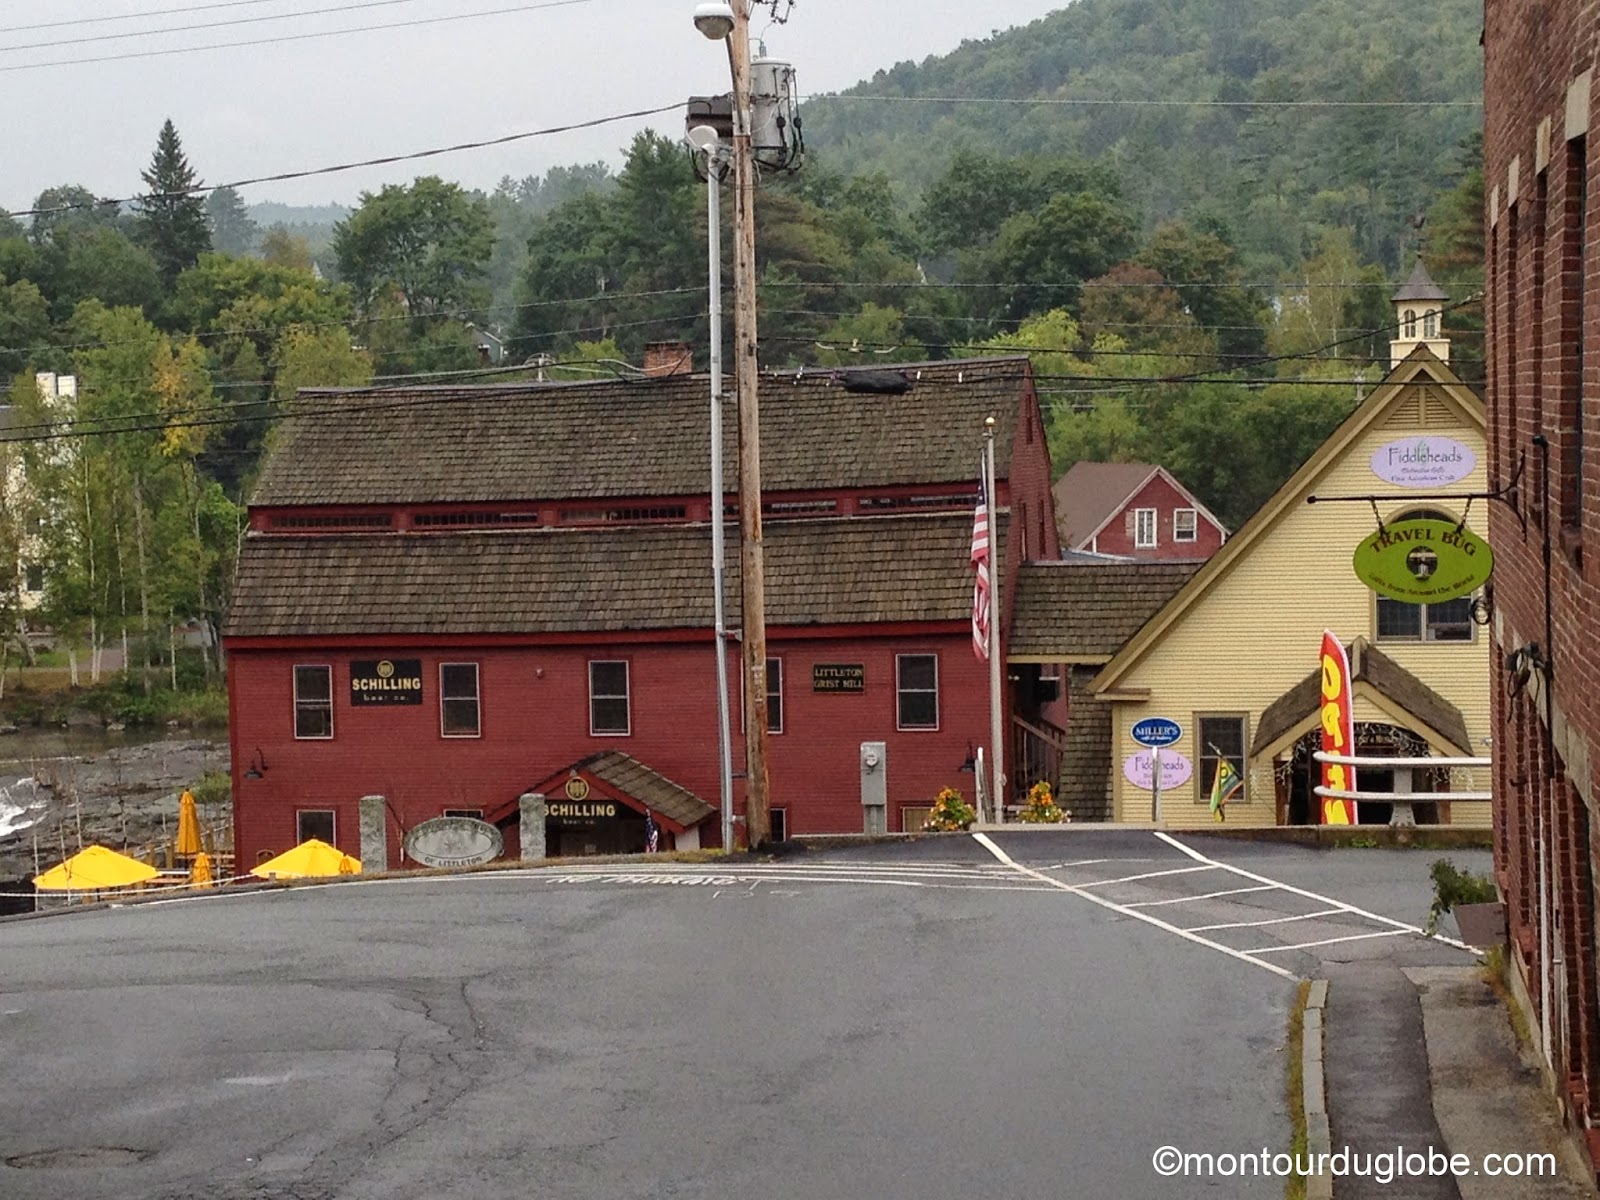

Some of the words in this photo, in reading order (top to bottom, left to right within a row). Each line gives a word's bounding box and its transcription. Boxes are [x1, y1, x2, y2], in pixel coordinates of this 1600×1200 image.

[1388, 446, 1463, 466] Fiddleheads
[1370, 528, 1434, 553] TRAVEL
[1441, 530, 1477, 557] BUG
[815, 668, 863, 677] LITTLETON
[352, 677, 421, 691] SCHILLING
[814, 679, 841, 688] GRIST
[1135, 726, 1179, 737] MILLER'S
[543, 803, 616, 817] SCHILLING
